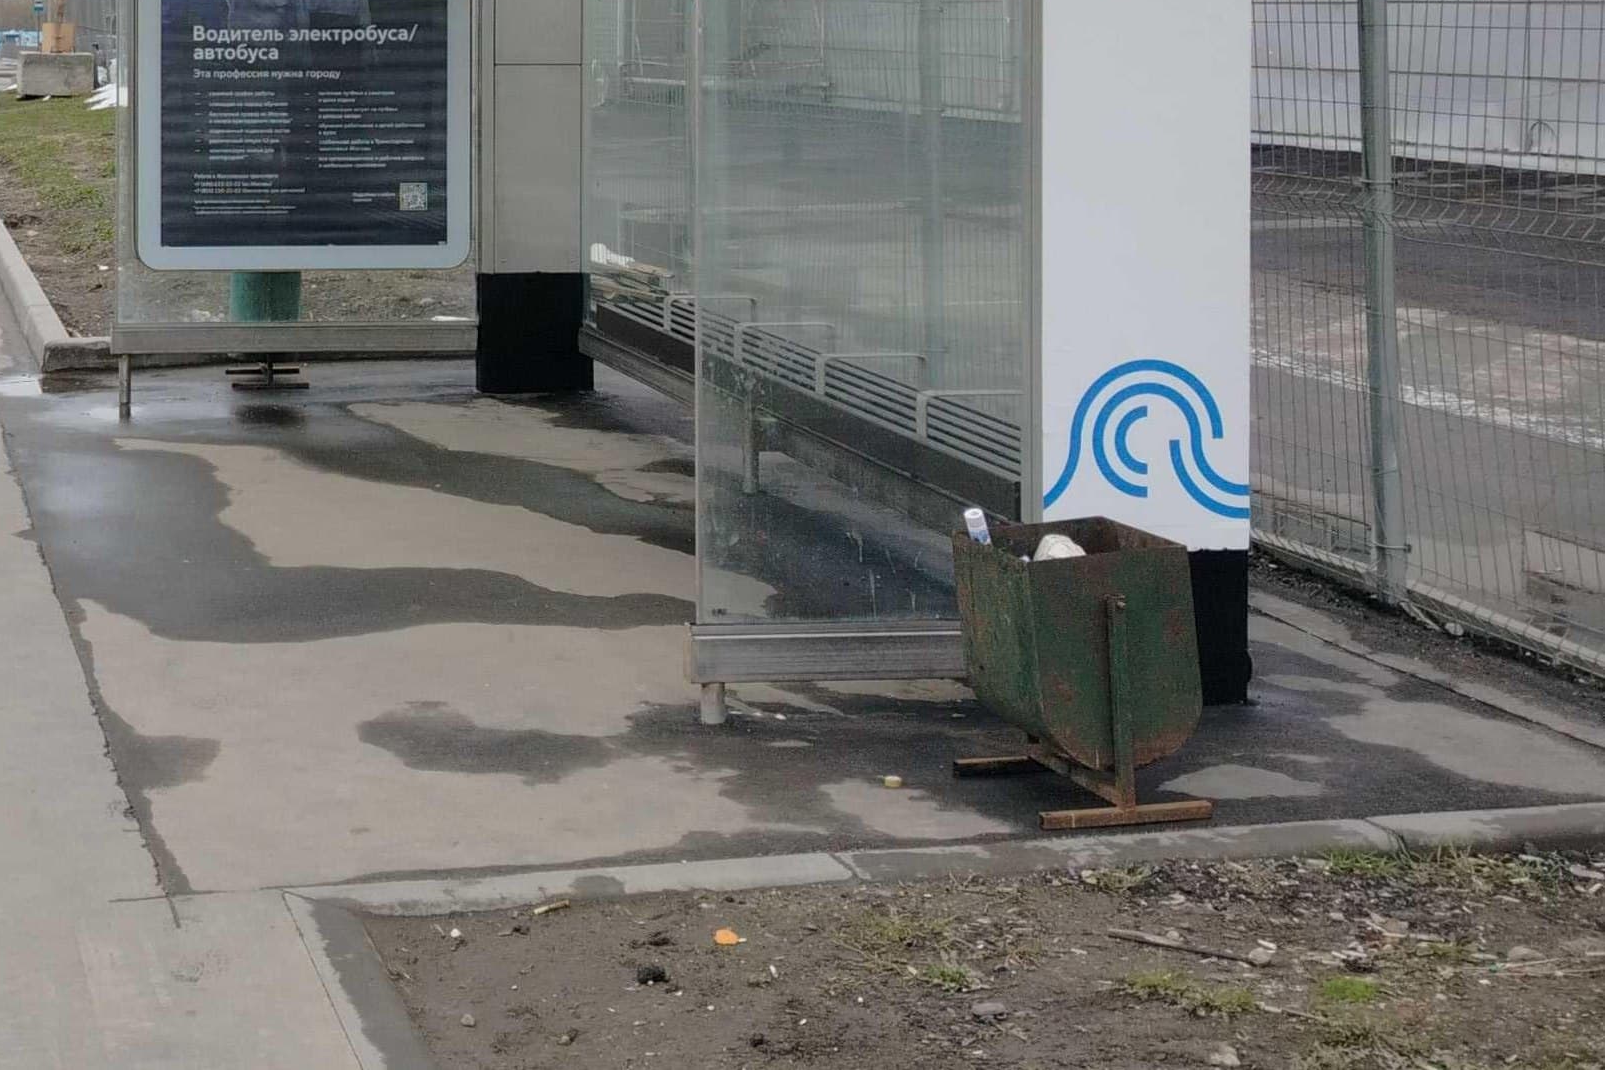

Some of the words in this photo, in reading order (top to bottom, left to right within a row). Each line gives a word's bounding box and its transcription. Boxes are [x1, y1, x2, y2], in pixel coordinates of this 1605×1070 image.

[192, 25, 284, 44] Водитель
[289, 24, 418, 44] электробуса/
[193, 44, 279, 64] автобуса
[193, 69, 211, 78] Эта
[213, 68, 269, 79] профессия
[271, 69, 303, 80] нужна
[305, 69, 341, 80] городу
